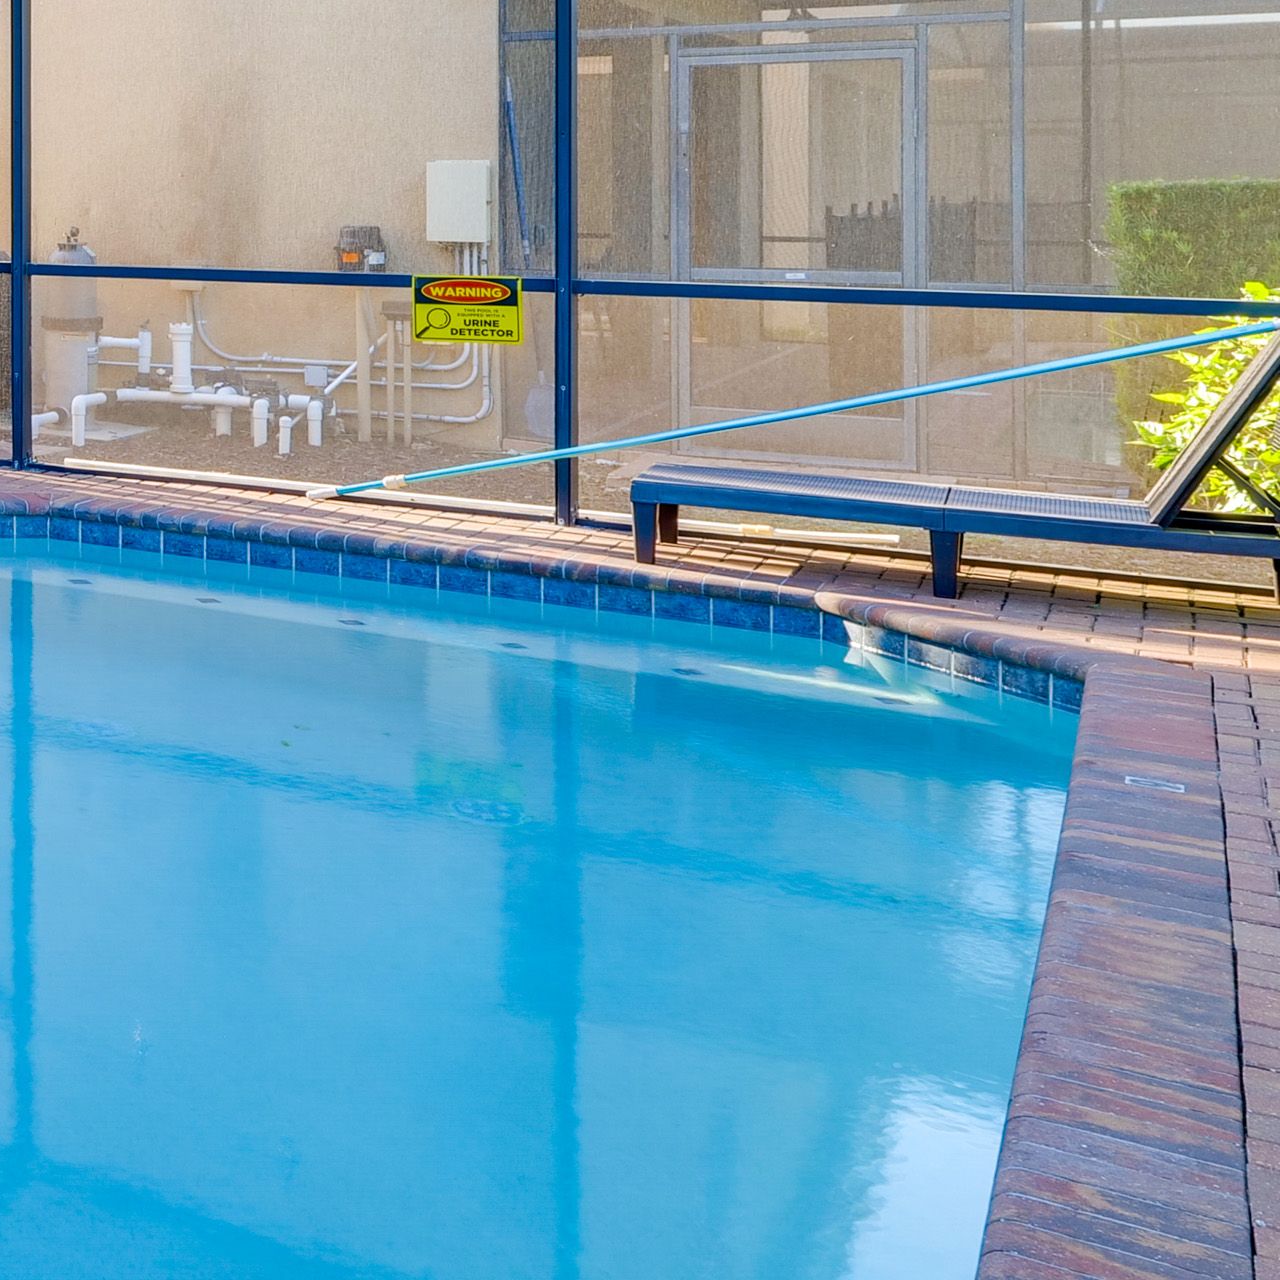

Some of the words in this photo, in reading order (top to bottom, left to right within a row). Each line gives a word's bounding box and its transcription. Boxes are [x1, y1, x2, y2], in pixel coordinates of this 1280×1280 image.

[429, 286, 502, 298] WARNING
[464, 319, 500, 328] URINE
[450, 328, 514, 337] DETECTOR
